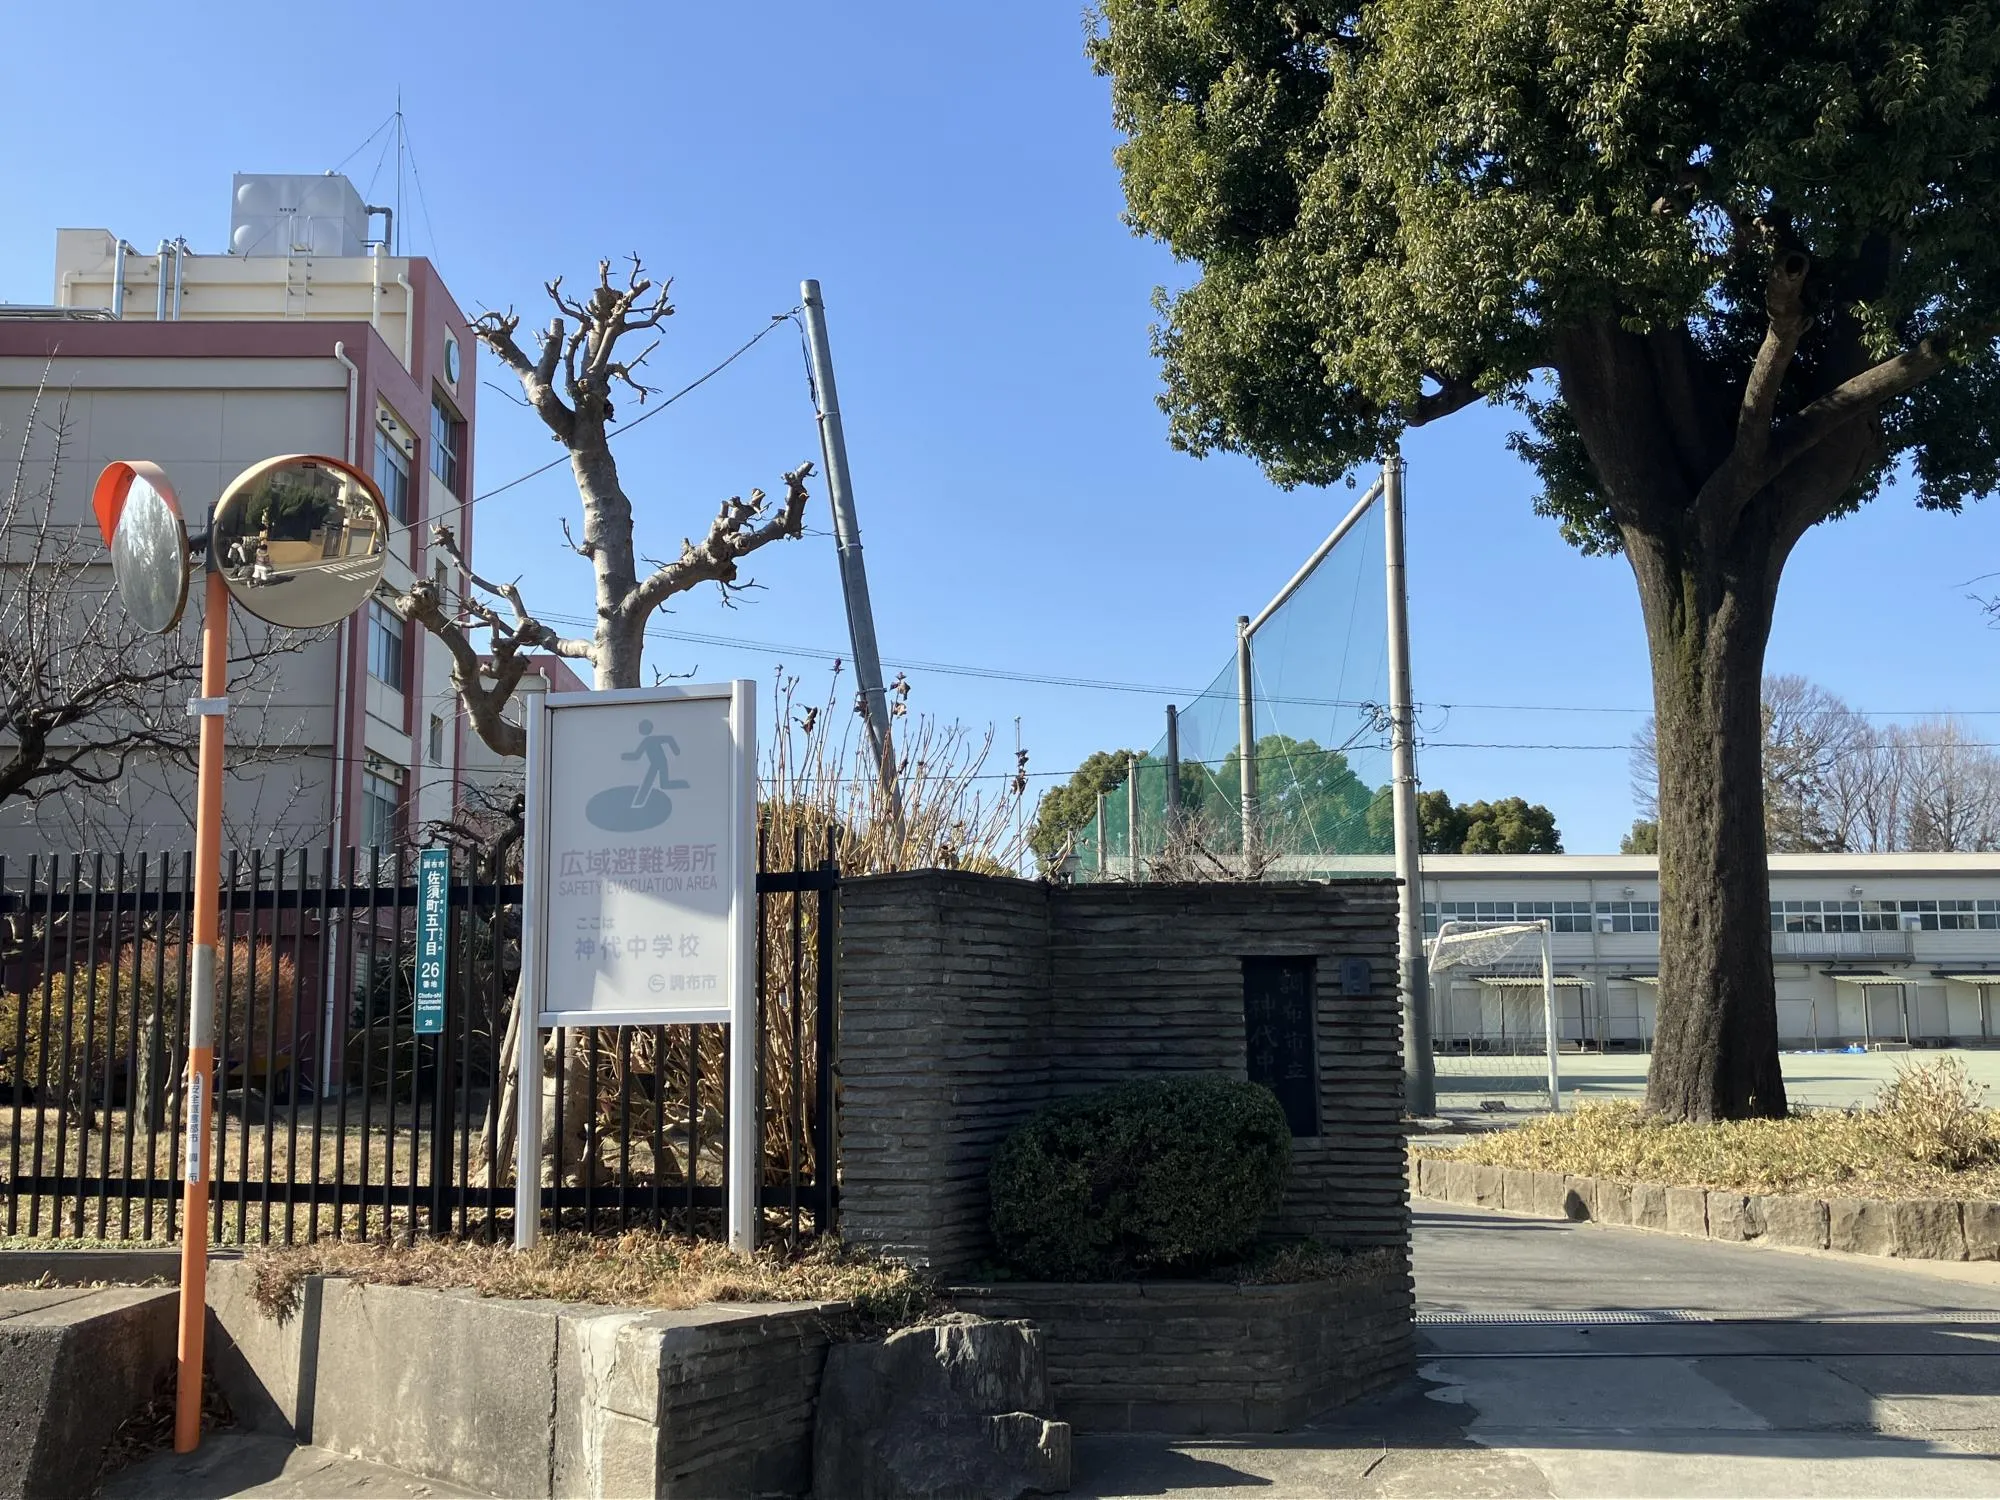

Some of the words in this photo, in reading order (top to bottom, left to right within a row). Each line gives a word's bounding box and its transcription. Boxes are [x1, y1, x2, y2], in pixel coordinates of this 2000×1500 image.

[423, 860, 445, 868] 調布市
[560, 843, 718, 877] 広域避難場所
[558, 879, 602, 897] SAFETY
[606, 876, 683, 896] EVACUATION
[686, 875, 718, 892] AREA
[425, 870, 440, 956] 佐須町五丁目
[576, 916, 615, 930] ここは
[575, 934, 700, 962] 神代中学校
[421, 961, 440, 978] 26
[422, 980, 438, 988] 番地
[669, 973, 717, 991] 調布市
[1279, 970, 1308, 1079] 調布市立
